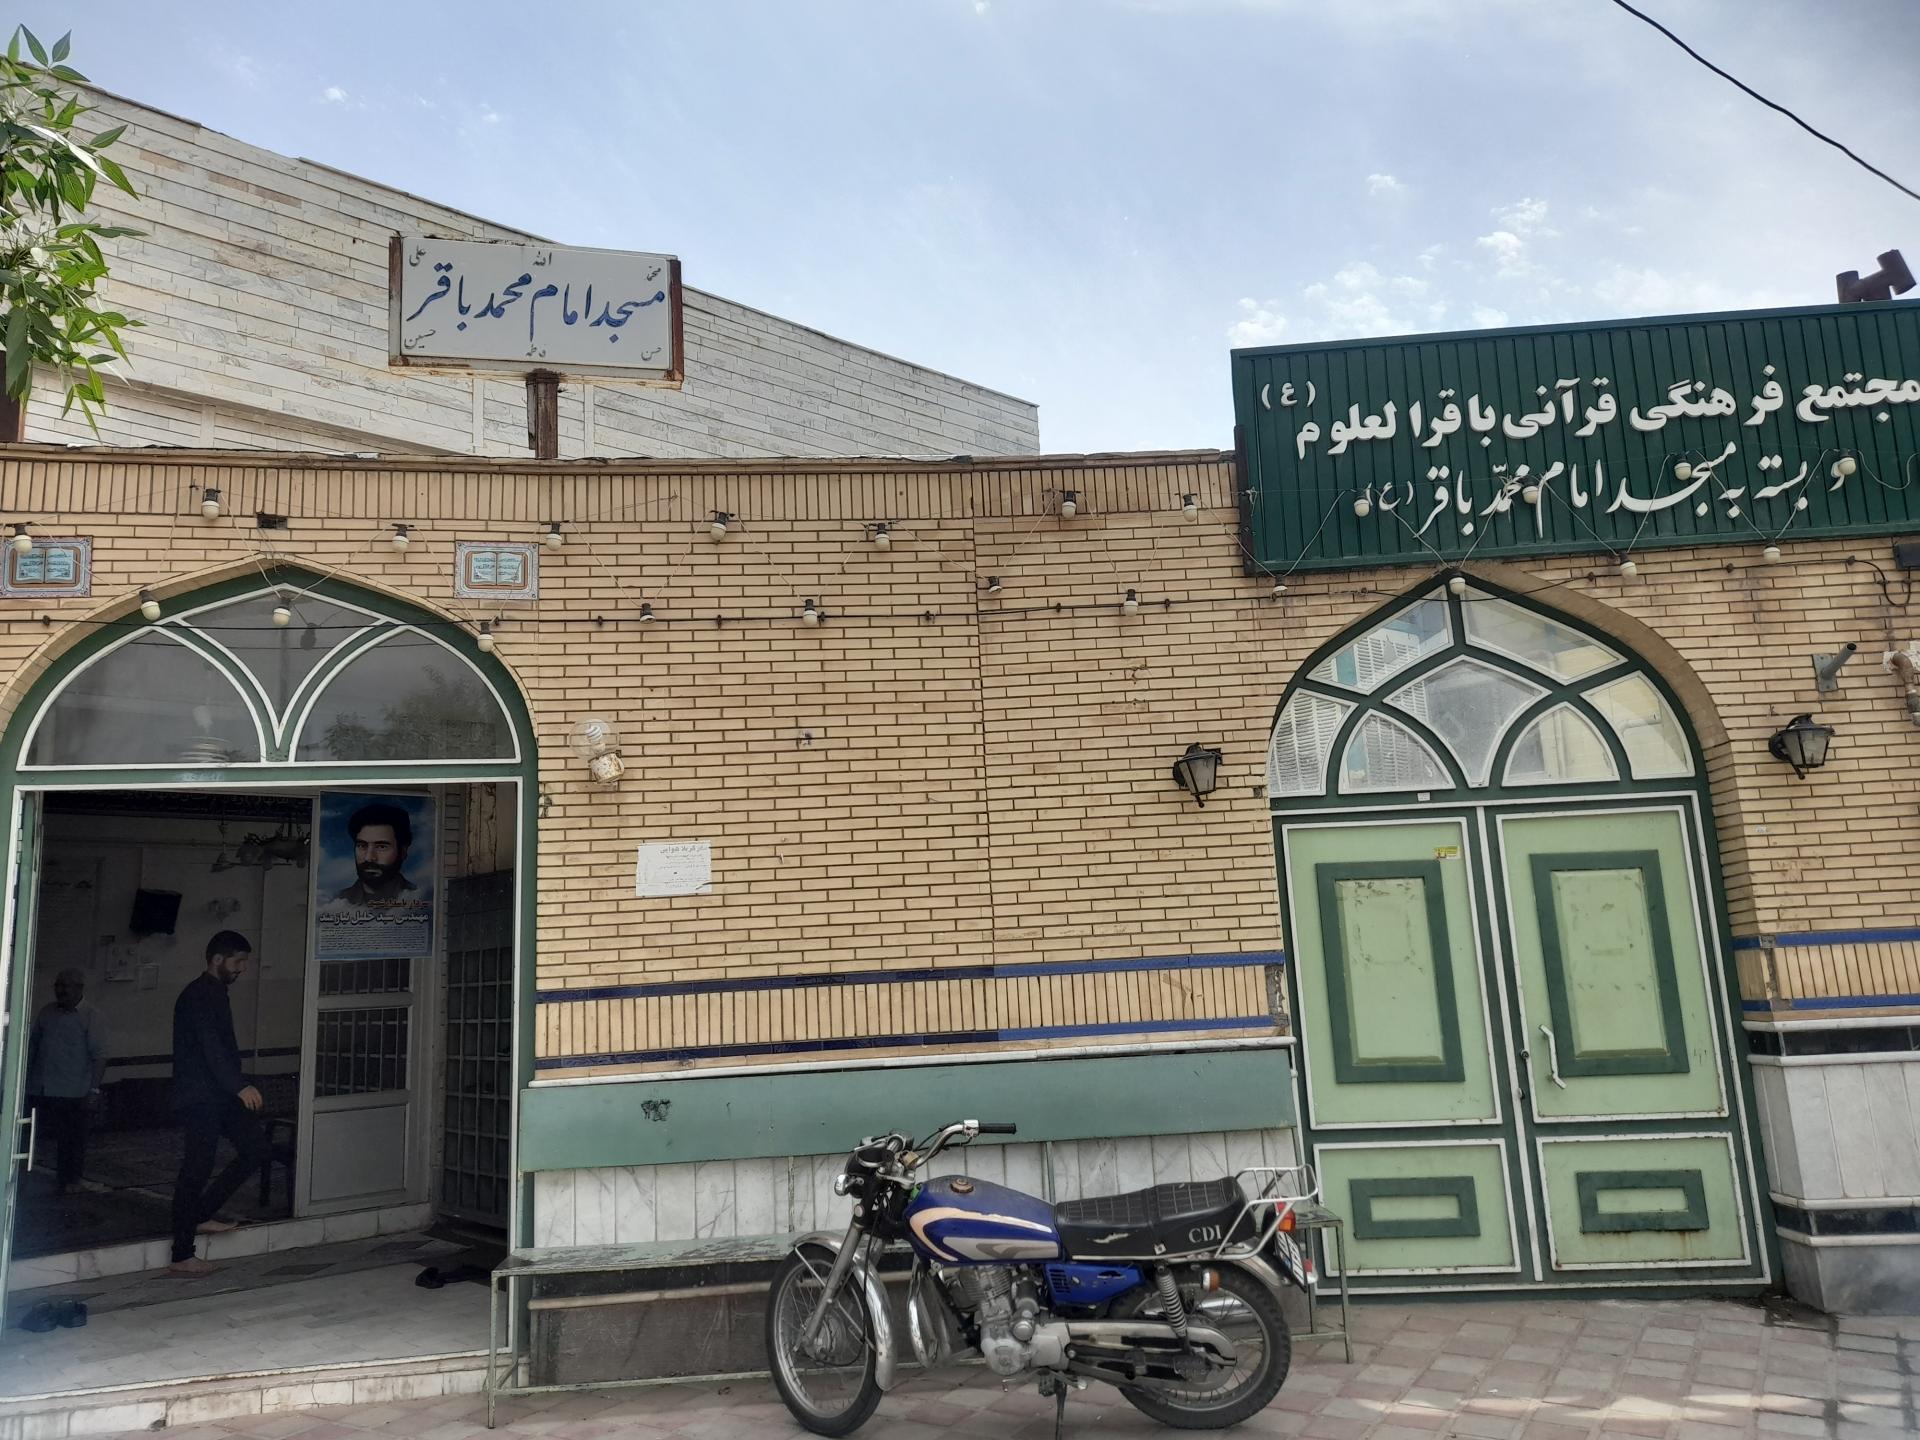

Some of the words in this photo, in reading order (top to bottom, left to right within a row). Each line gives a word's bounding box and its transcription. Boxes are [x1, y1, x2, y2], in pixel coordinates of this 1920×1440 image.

[406, 262, 471, 332] باقر
[473, 272, 532, 318] محمد
[529, 282, 592, 342] امام
[589, 290, 666, 344] مسجد
[404, 328, 436, 350] حسین
[641, 346, 662, 362] حسن
[1502, 376, 1617, 439] قرآنی
[1629, 363, 1784, 432] فرهنگی
[1795, 372, 1920, 423] مجتمع
[1413, 465, 1474, 537] باقر
[1535, 459, 1604, 539] امام
[1605, 441, 1737, 518] مسجد
[351, 910, 375, 926] خلیل
[395, 912, 429, 925] مهندس
[1188, 1224, 1222, 1243] CDI
